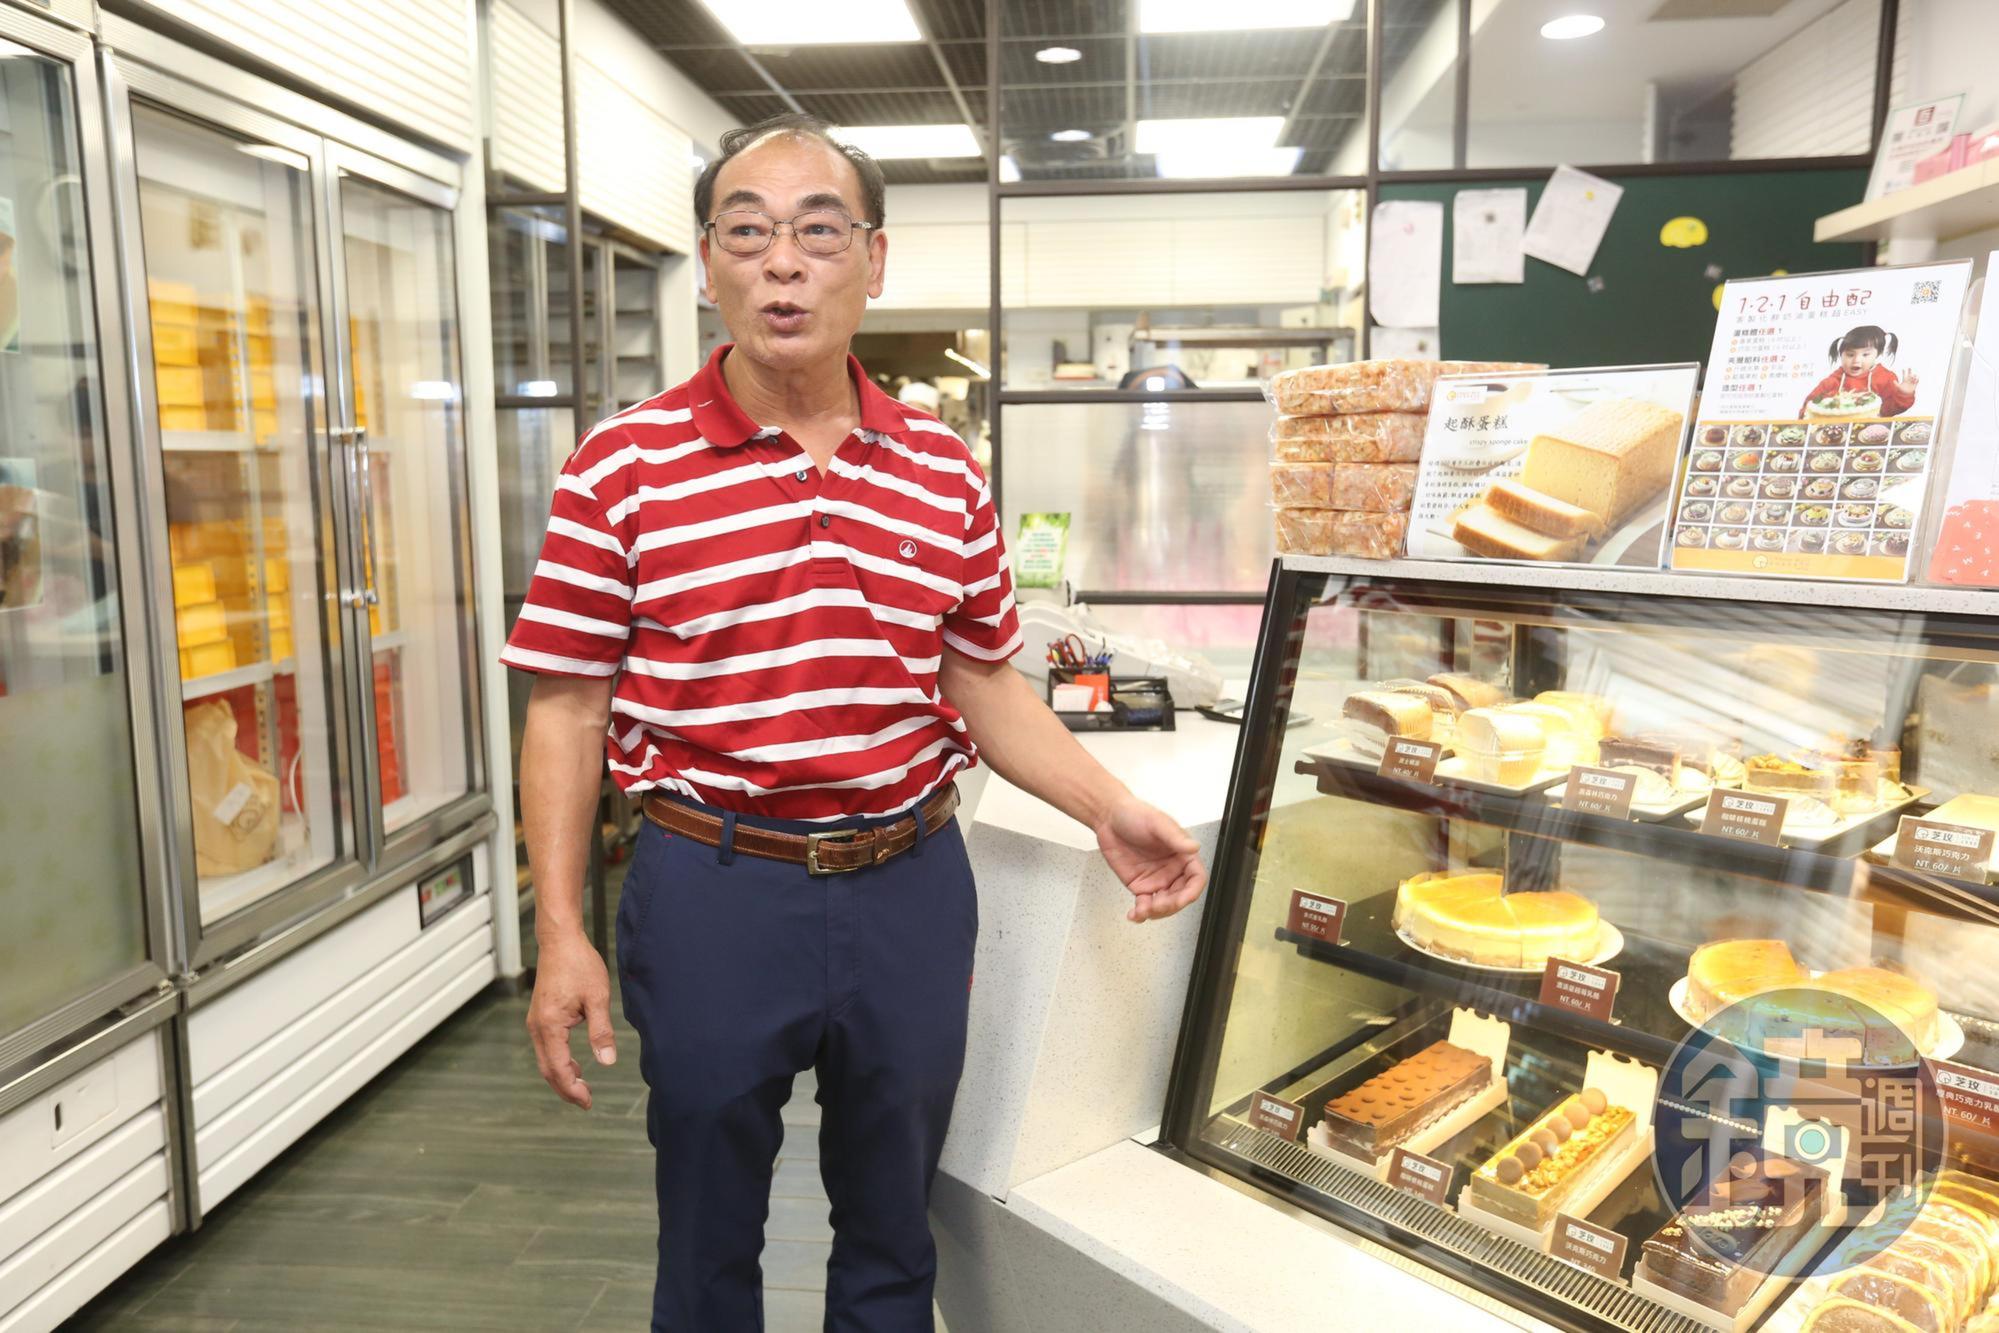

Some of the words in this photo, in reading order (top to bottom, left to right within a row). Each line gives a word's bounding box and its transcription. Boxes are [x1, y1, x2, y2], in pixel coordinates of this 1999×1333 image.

[1796, 288, 1872, 310] 自由配
[1443, 415, 1509, 432] 起酥蛋糕
[1489, 438, 1511, 446] sponge
[1932, 831, 1953, 842] 芝玫
[1932, 862, 1949, 872] 60/
[1955, 1076, 1980, 1091] 芝玫
[1960, 1110, 1977, 1122] 60/
[1982, 1116, 1991, 1126] 片
